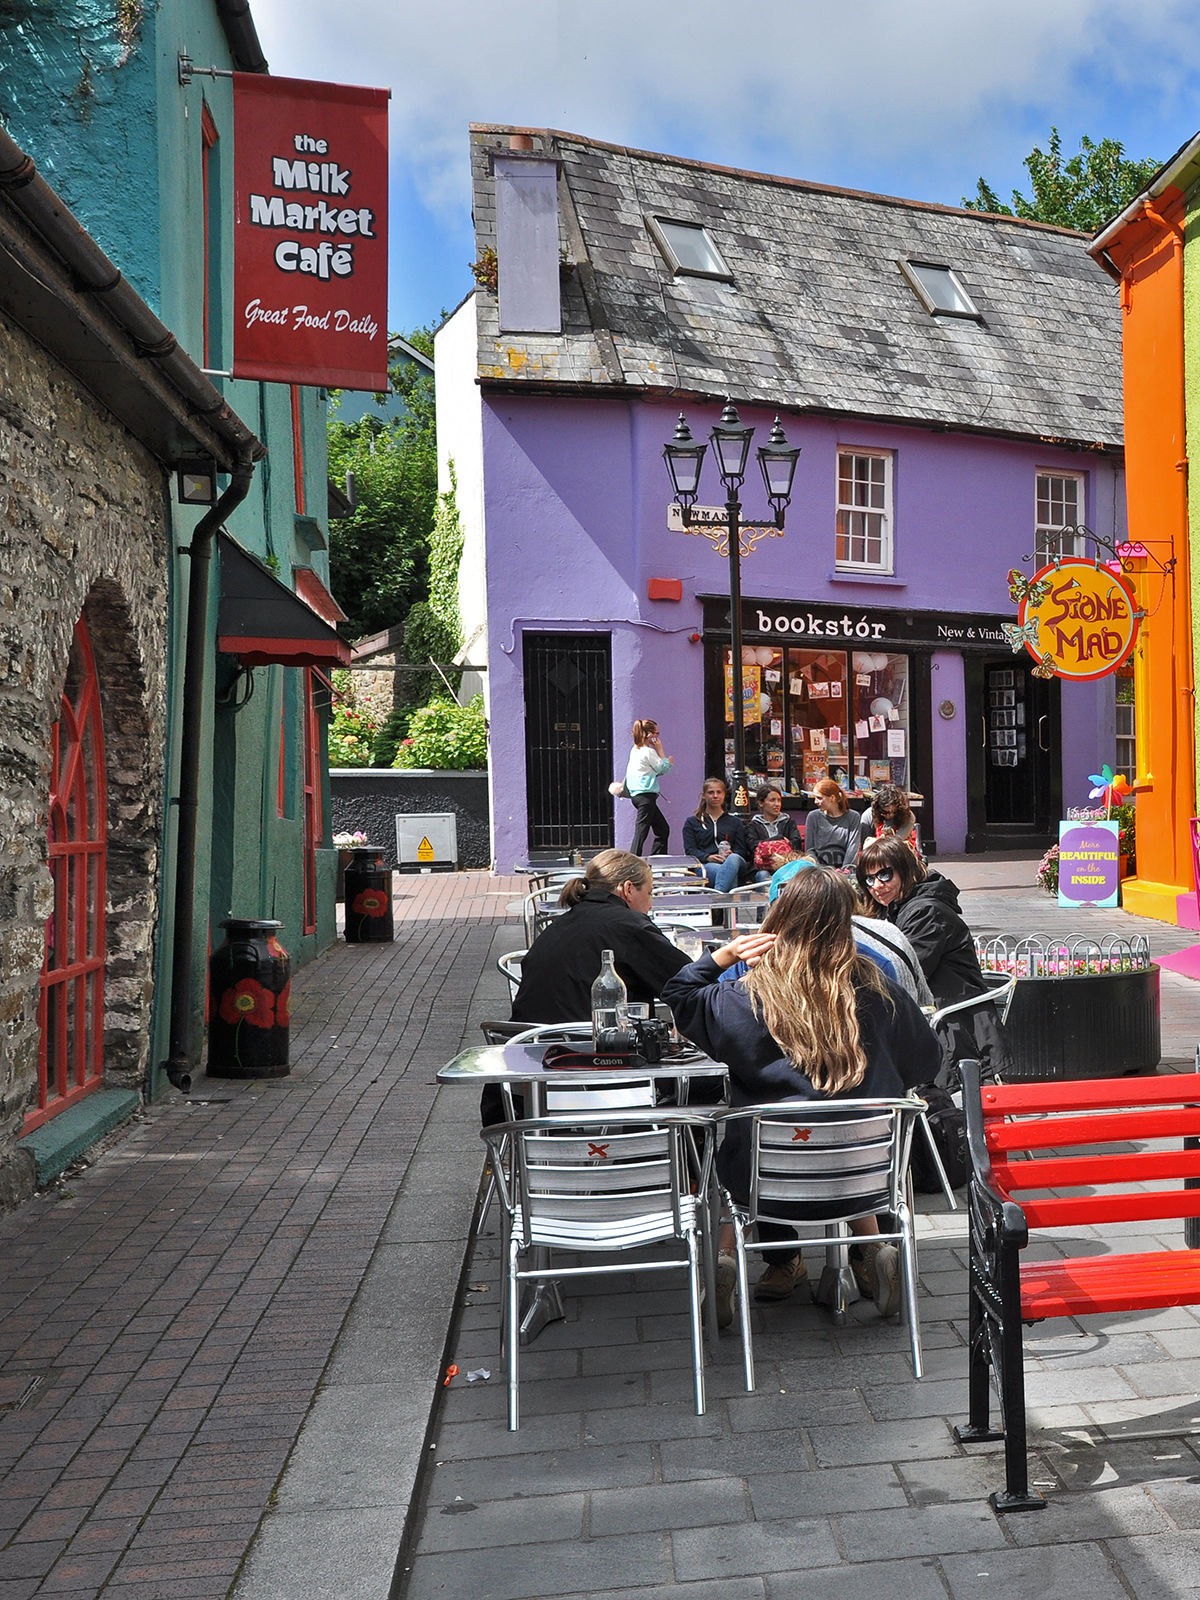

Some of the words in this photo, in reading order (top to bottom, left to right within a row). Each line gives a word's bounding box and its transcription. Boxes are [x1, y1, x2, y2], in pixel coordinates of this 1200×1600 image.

[294, 134, 328, 154] the
[272, 157, 350, 195] Milk
[250, 194, 375, 237] Market
[244, 298, 288, 329] Great
[292, 305, 330, 331] Food
[334, 308, 379, 341] Daily
[756, 610, 887, 639] bookstór
[937, 625, 965, 639] New
[966, 628, 976, 639] &
[977, 628, 1013, 645] Vintag
[1060, 852, 1118, 860] BEAUTIFUL
[1071, 875, 1106, 885] INSIDE
[592, 1057, 623, 1066] Canon
